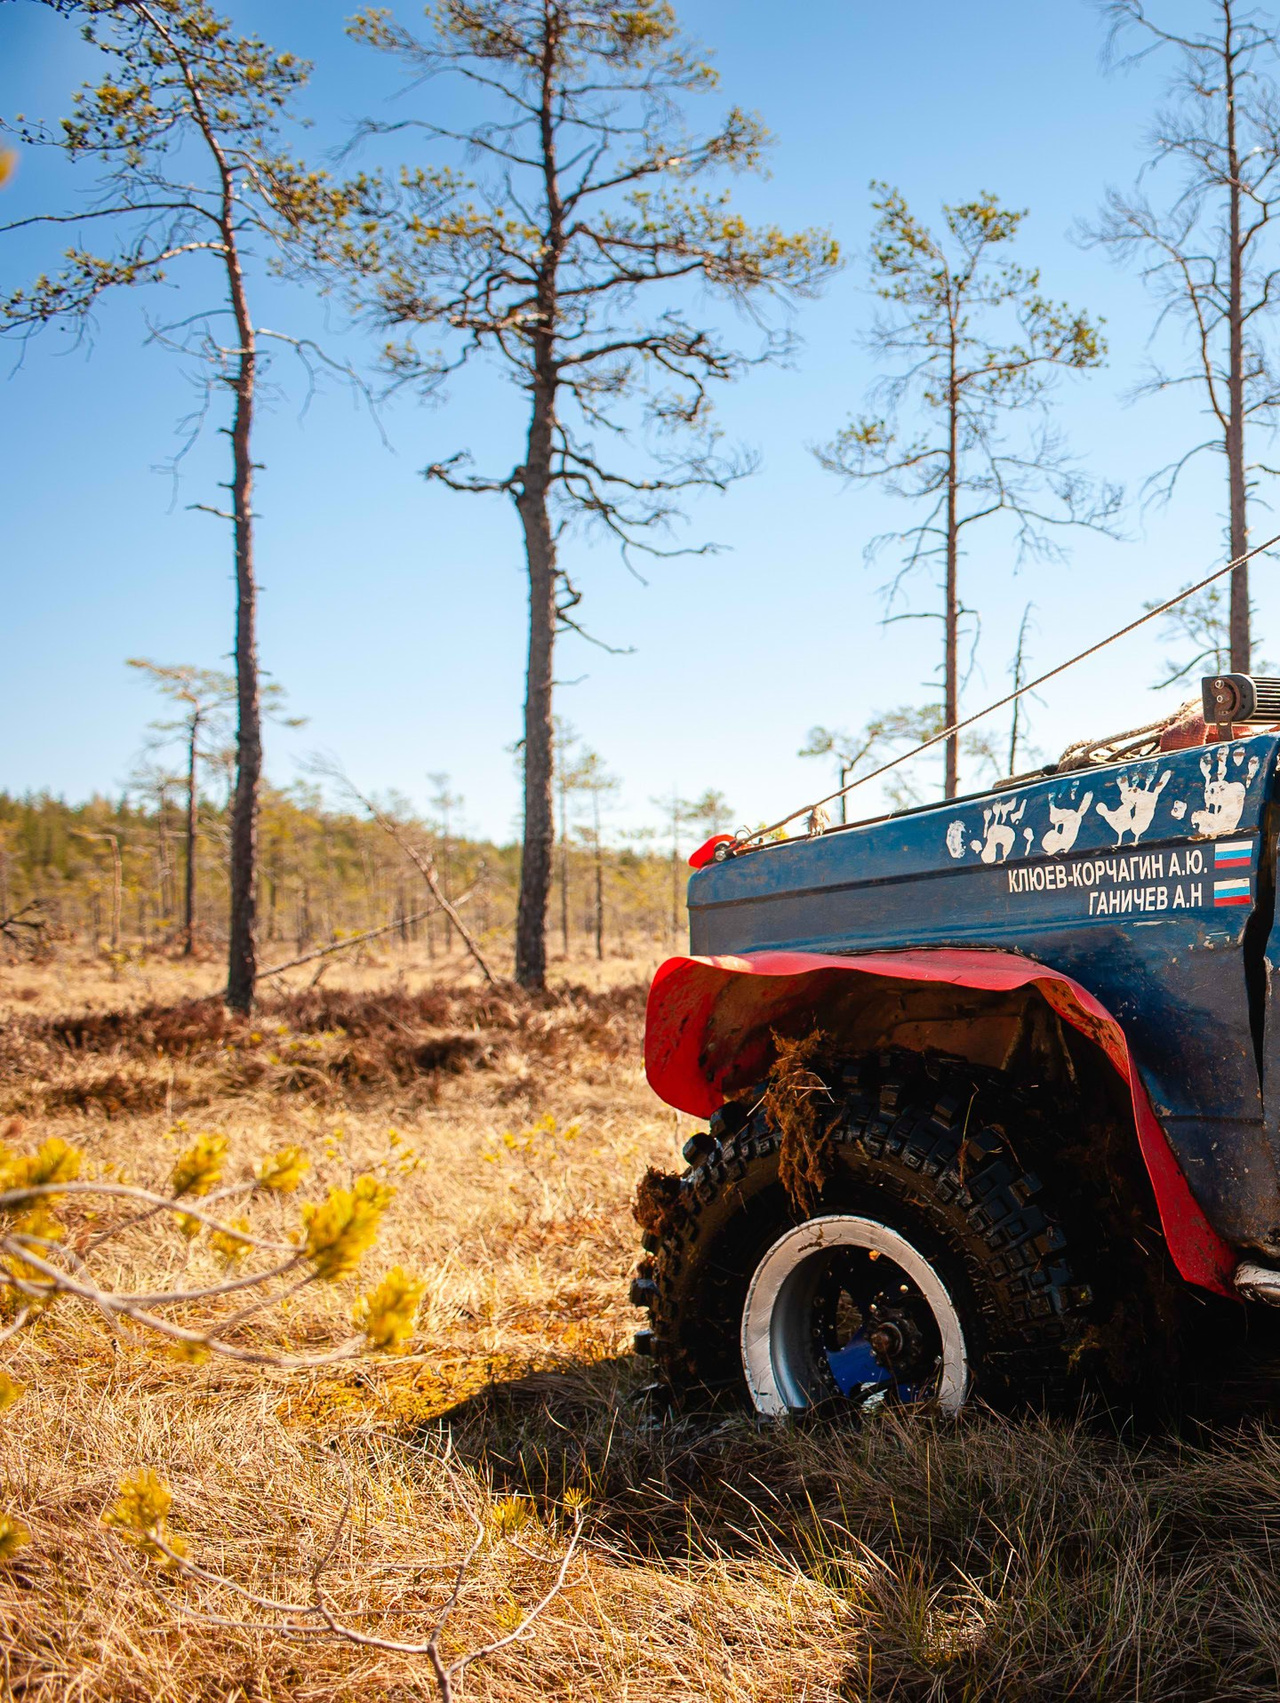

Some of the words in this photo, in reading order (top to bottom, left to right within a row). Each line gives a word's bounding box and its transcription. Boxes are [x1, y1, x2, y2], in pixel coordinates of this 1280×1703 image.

[1008, 854, 1165, 893] КЛЮЕВ-КОРЧАГИН
[1168, 849, 1208, 878] А.Ю.
[1088, 886, 1168, 916] ГАНИЧЕВ
[1173, 883, 1203, 909] А.Н
